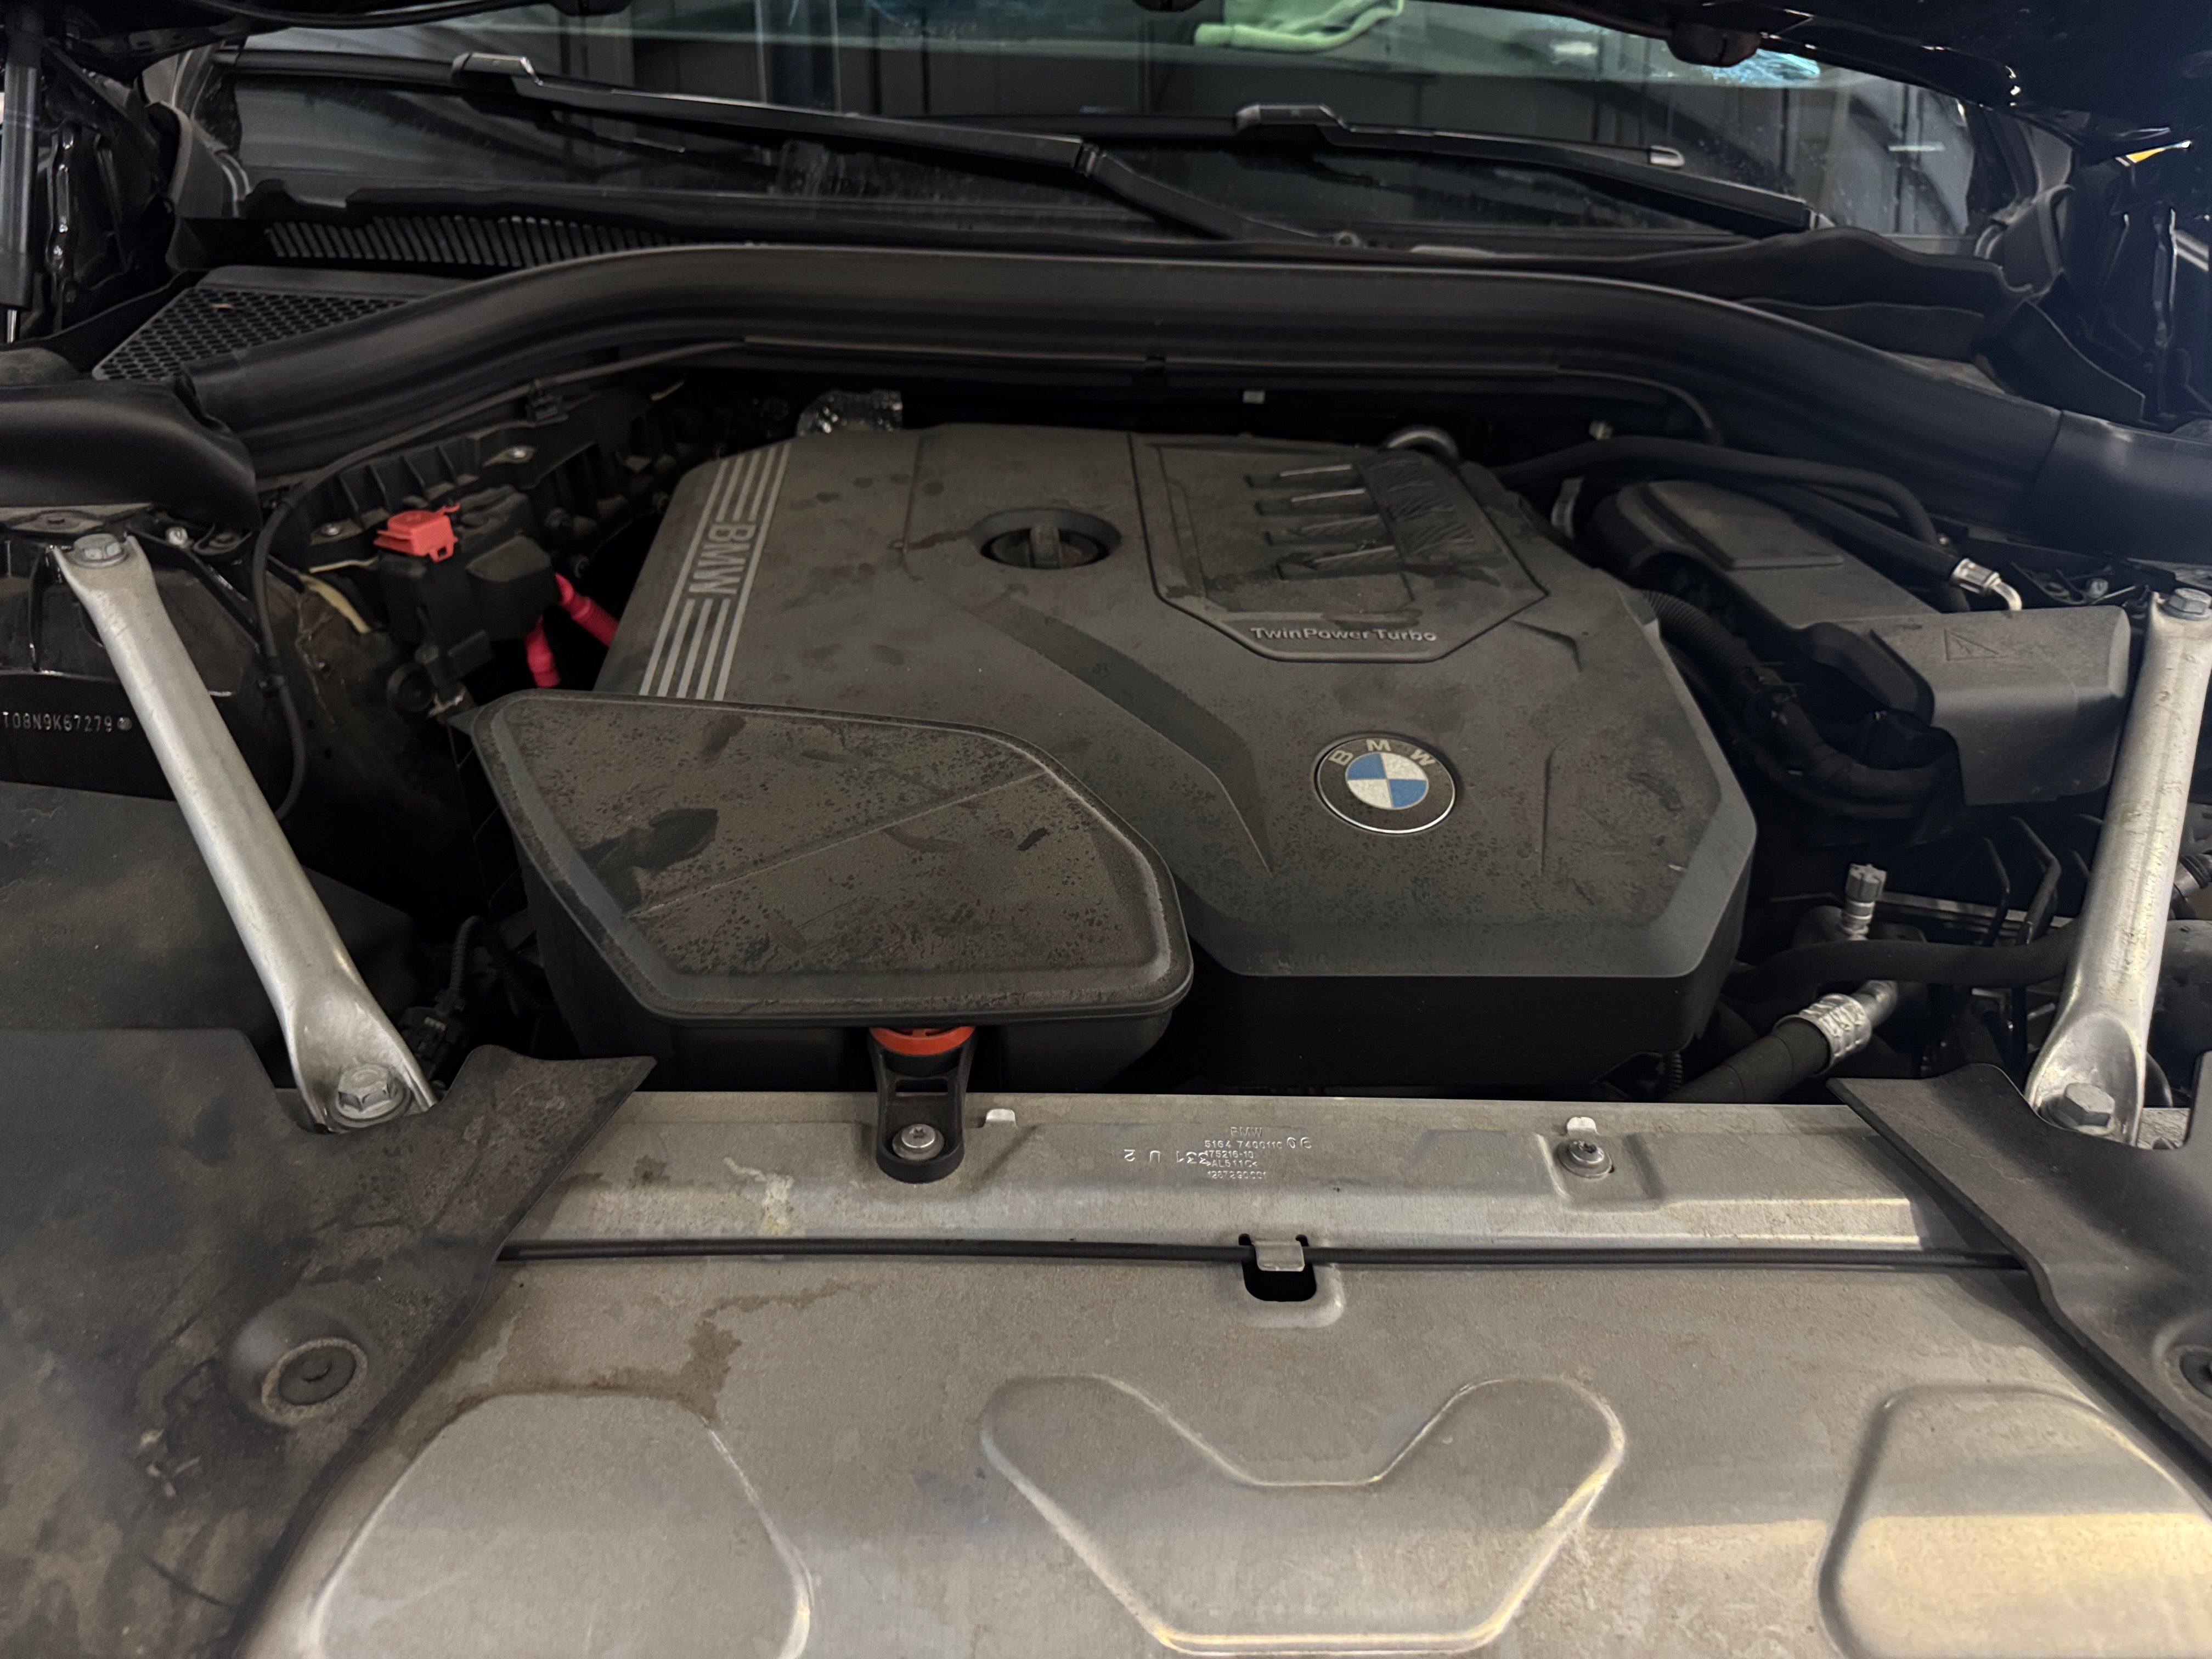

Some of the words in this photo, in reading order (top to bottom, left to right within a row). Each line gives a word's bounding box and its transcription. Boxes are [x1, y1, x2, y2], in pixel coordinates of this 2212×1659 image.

[689, 524, 758, 595] BMW
[1251, 627, 1369, 640] TwinPower
[1372, 629, 1438, 641] Turbo
[1328, 738, 1437, 766] BMW
[1230, 1126, 1263, 1138] BMW
